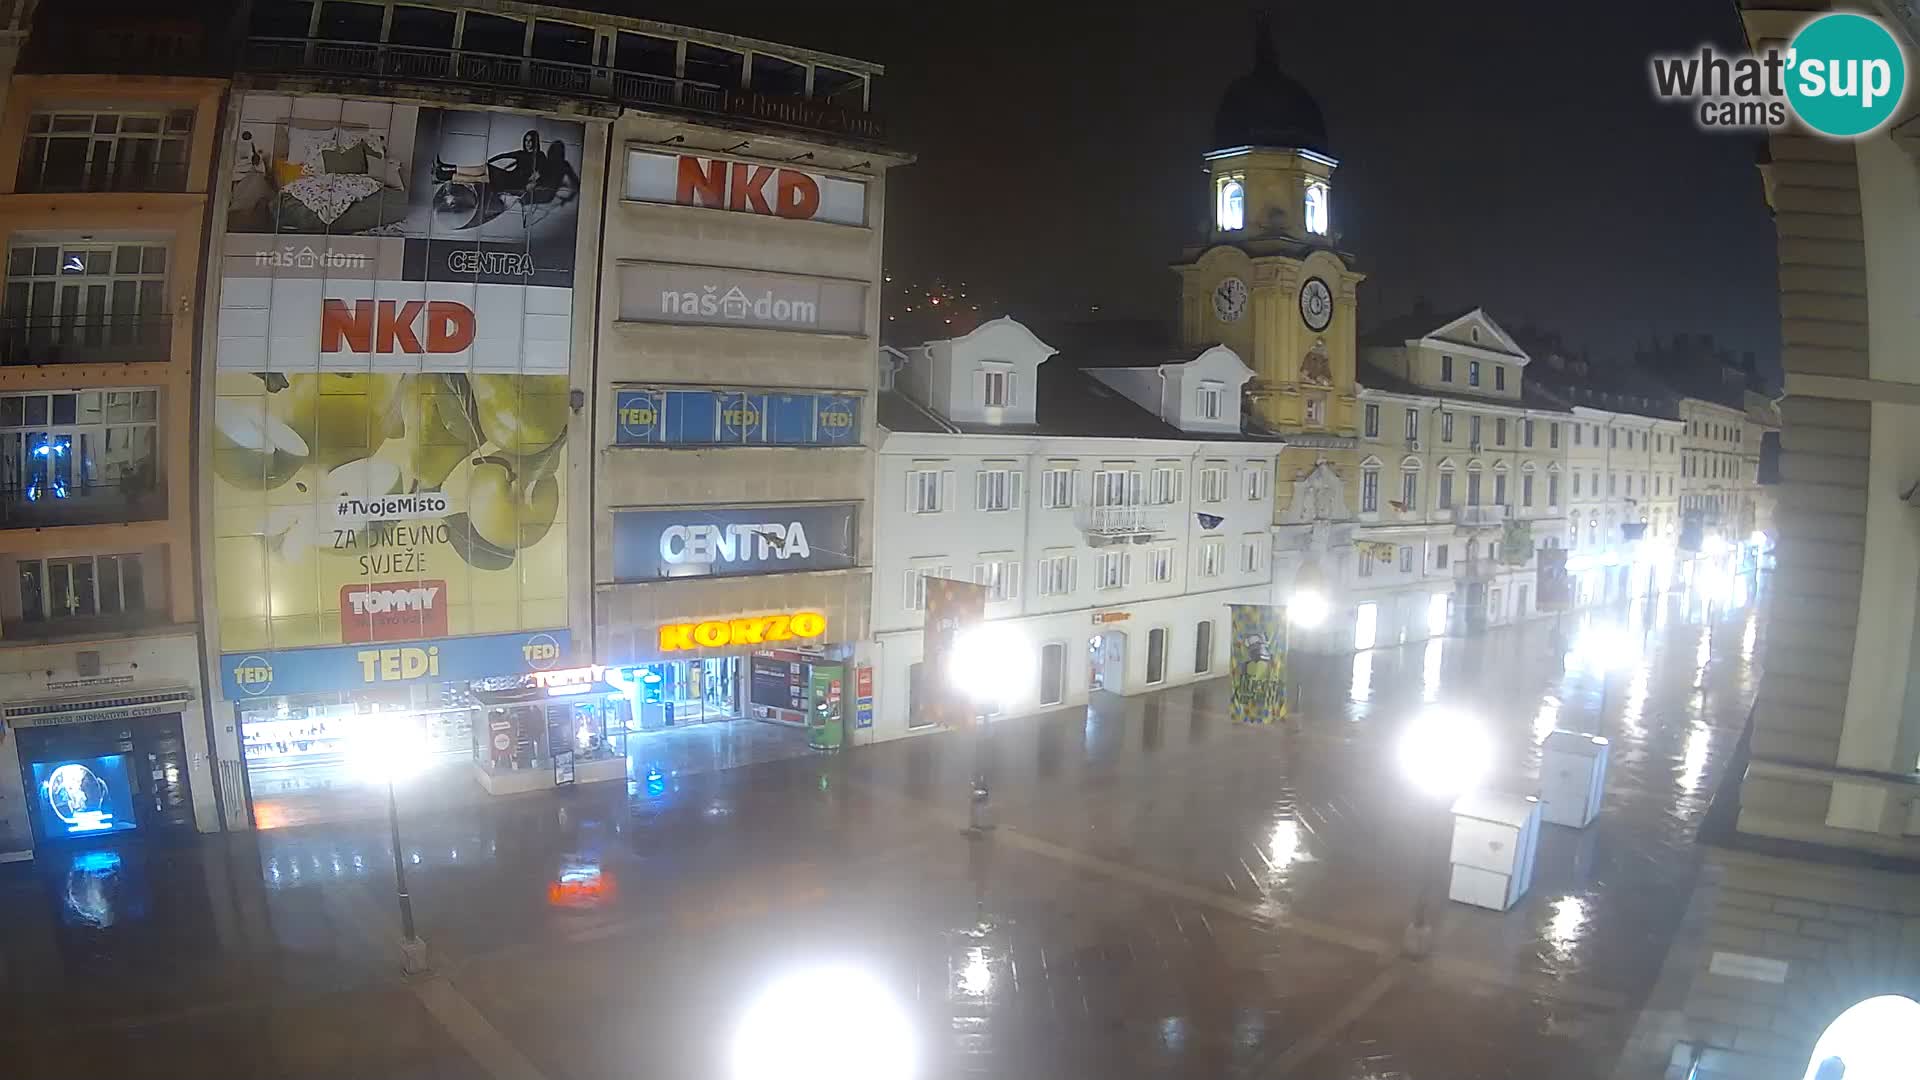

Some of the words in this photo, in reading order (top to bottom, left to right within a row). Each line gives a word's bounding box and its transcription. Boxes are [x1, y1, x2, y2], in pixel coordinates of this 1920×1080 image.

[676, 155, 820, 220] NKD
[255, 246, 294, 269] naš
[319, 248, 365, 269] dom
[448, 250, 534, 276] CENTRA
[661, 285, 717, 316] naš
[754, 291, 817, 323] dom
[321, 298, 477, 354] NKD
[619, 406, 657, 425] TEDi
[723, 408, 759, 426] TEDi
[820, 409, 853, 427] TEDi
[338, 497, 446, 516] #TvojeMisto
[333, 530, 358, 550] ZA
[367, 524, 449, 547] DNEVNO
[660, 522, 810, 563] CENTRA
[359, 546, 425, 576] SVJEŽE
[348, 587, 439, 614] TOMMY
[659, 611, 826, 652] KORZO
[522, 642, 560, 661] TEDi
[234, 666, 272, 684] TEDi
[358, 648, 439, 682] TEDi
